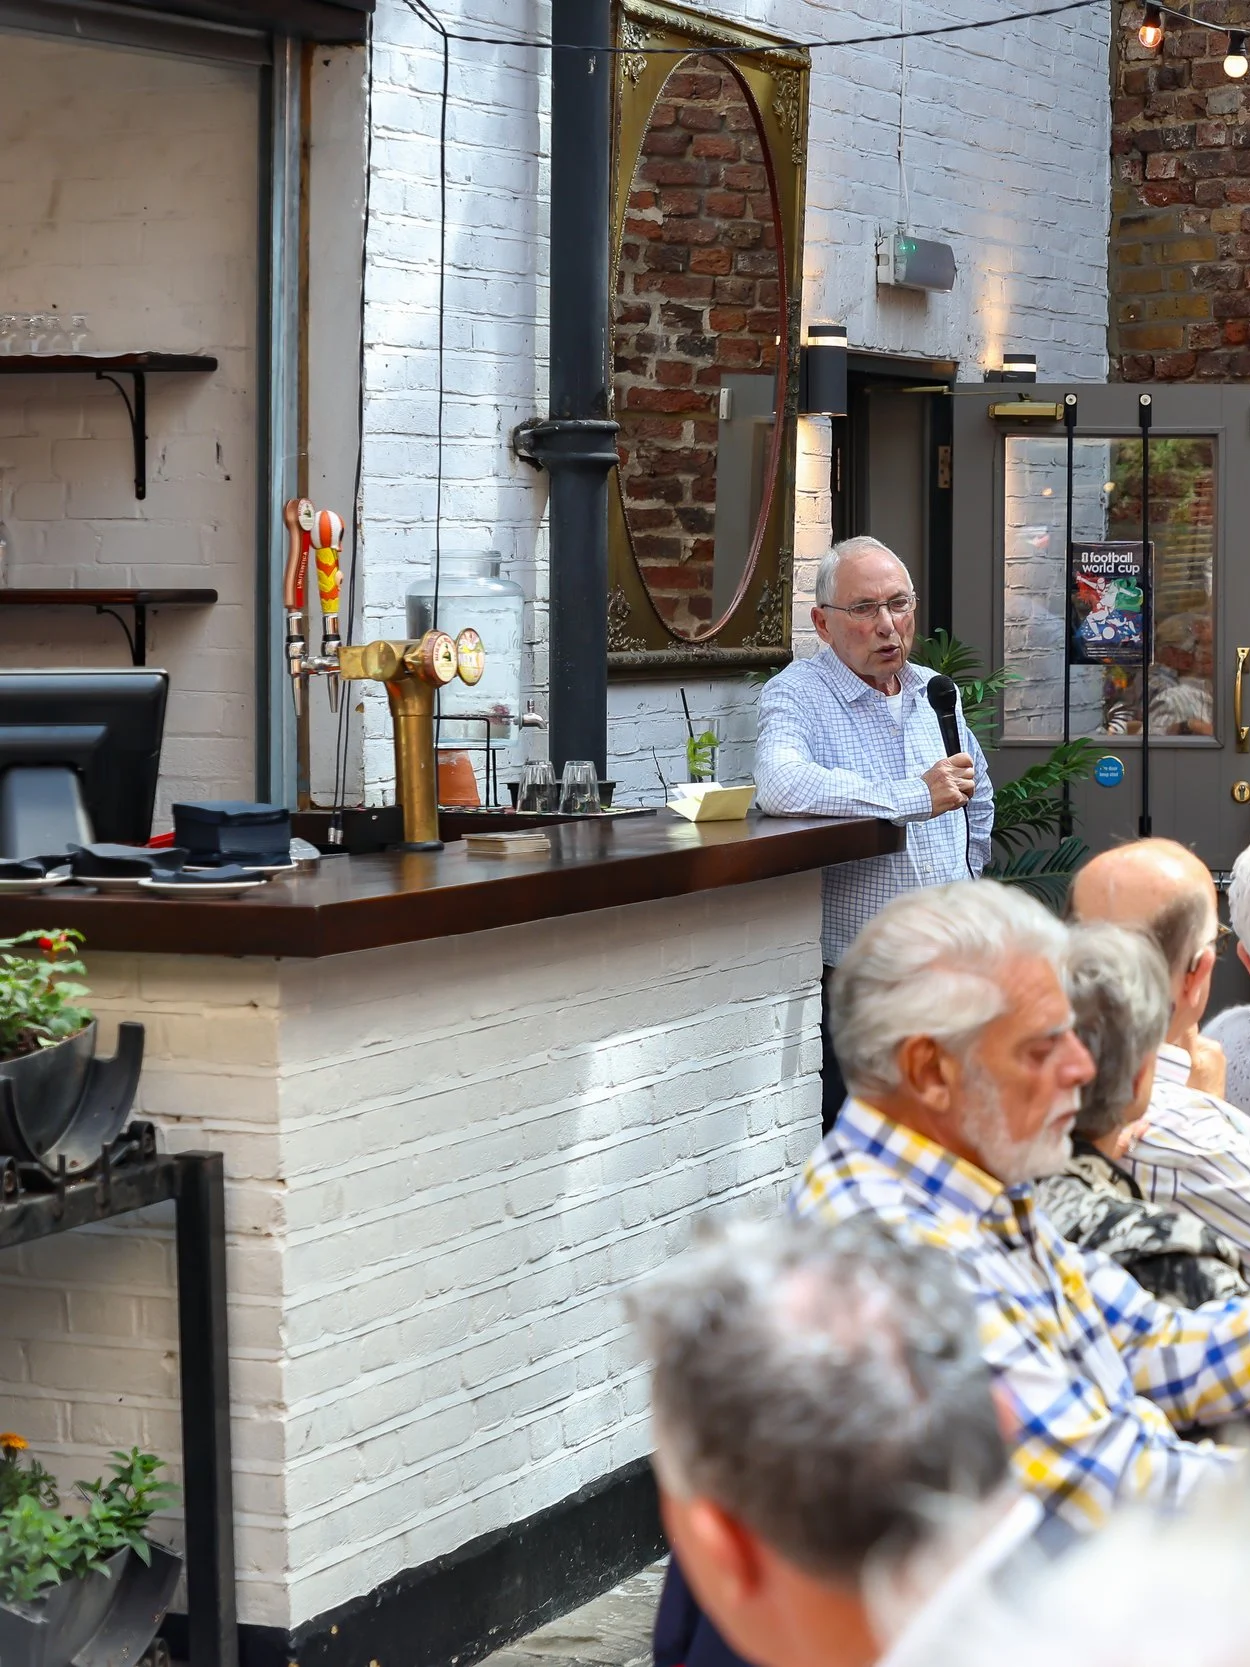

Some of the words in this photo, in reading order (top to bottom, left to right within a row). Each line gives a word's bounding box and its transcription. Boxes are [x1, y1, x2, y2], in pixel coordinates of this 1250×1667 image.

[1090, 552, 1133, 563] football
[1082, 562, 1115, 573] world
[1118, 564, 1140, 575] cup
